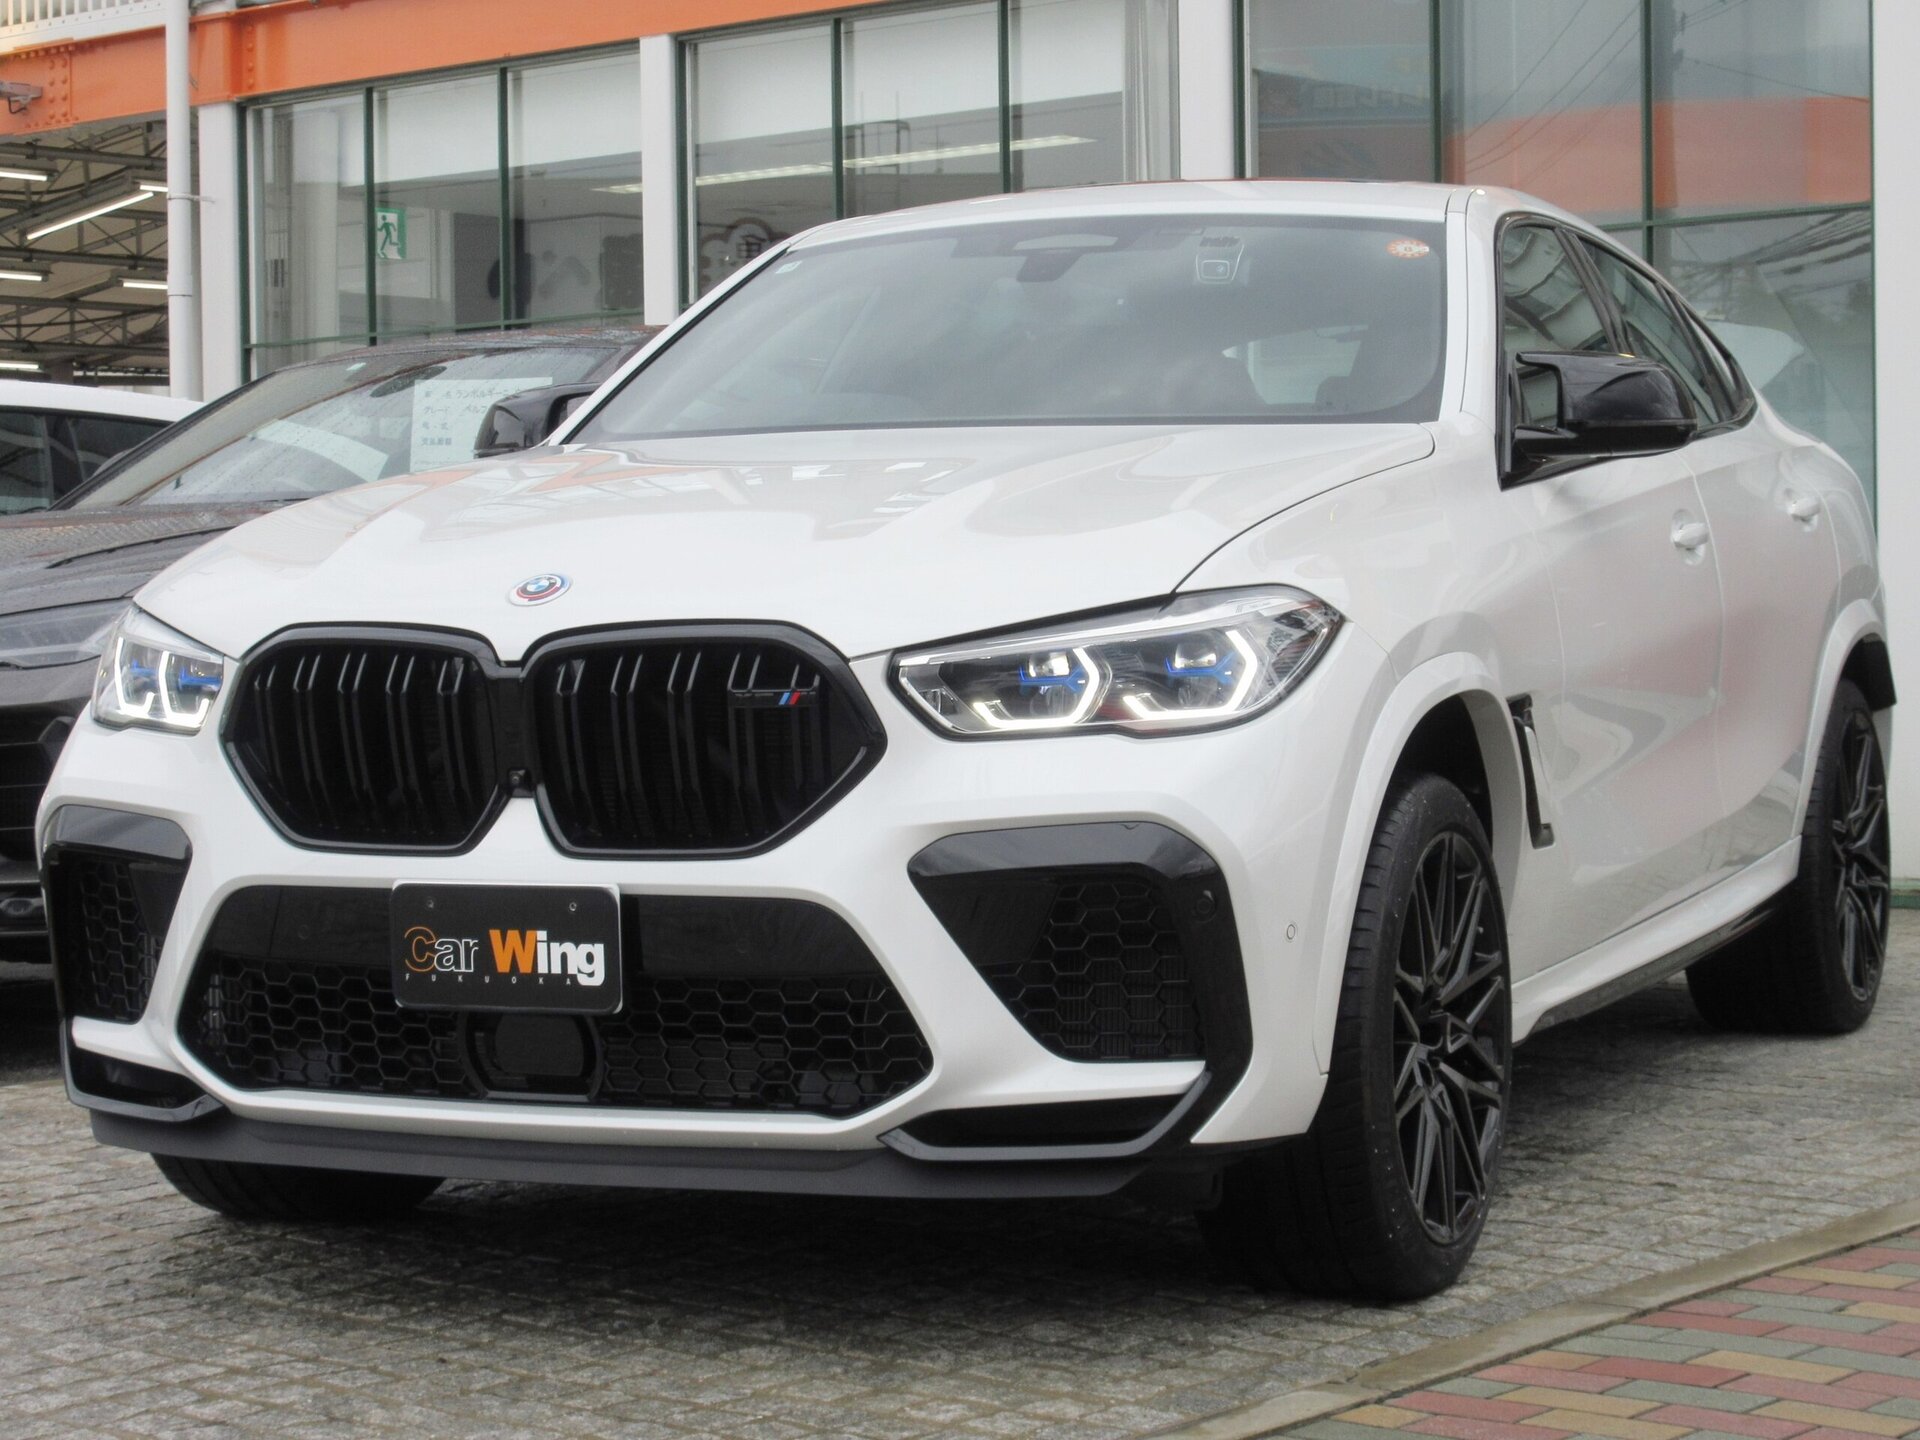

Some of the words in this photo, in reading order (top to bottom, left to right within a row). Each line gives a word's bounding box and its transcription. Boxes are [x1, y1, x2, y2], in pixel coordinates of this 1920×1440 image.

[404, 926, 479, 972] Car
[489, 929, 605, 986] Wing
[405, 974, 571, 986] FUKUOKA
